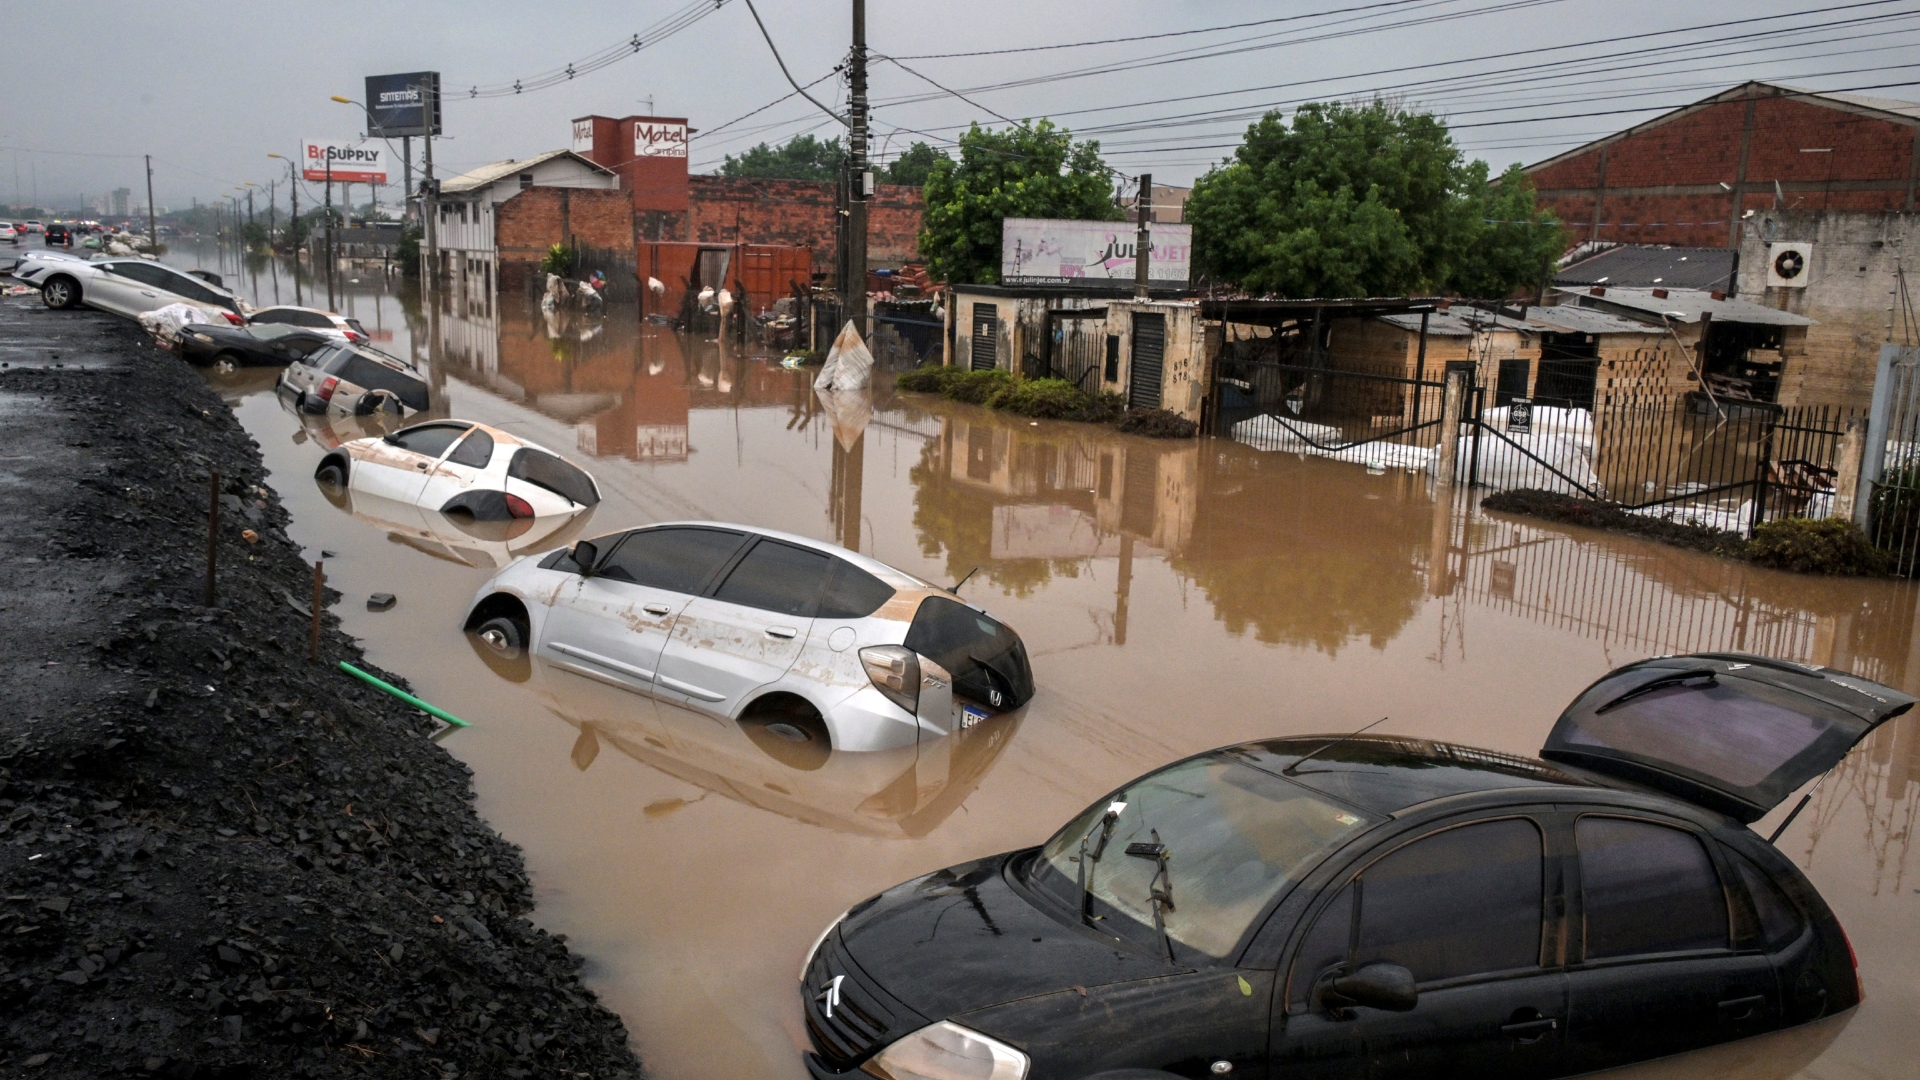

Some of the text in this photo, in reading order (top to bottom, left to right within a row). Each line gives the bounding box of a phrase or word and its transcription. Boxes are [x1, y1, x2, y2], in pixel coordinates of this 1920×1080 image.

[636, 124, 686, 144] Motel
[643, 145, 686, 157] Campina
[1059, 264, 1086, 278] 50%
[1157, 268, 1187, 280] 1187
[1173, 358, 1188, 371] 876
[1173, 371, 1188, 383] 878
[1513, 410, 1526, 418] GSP
